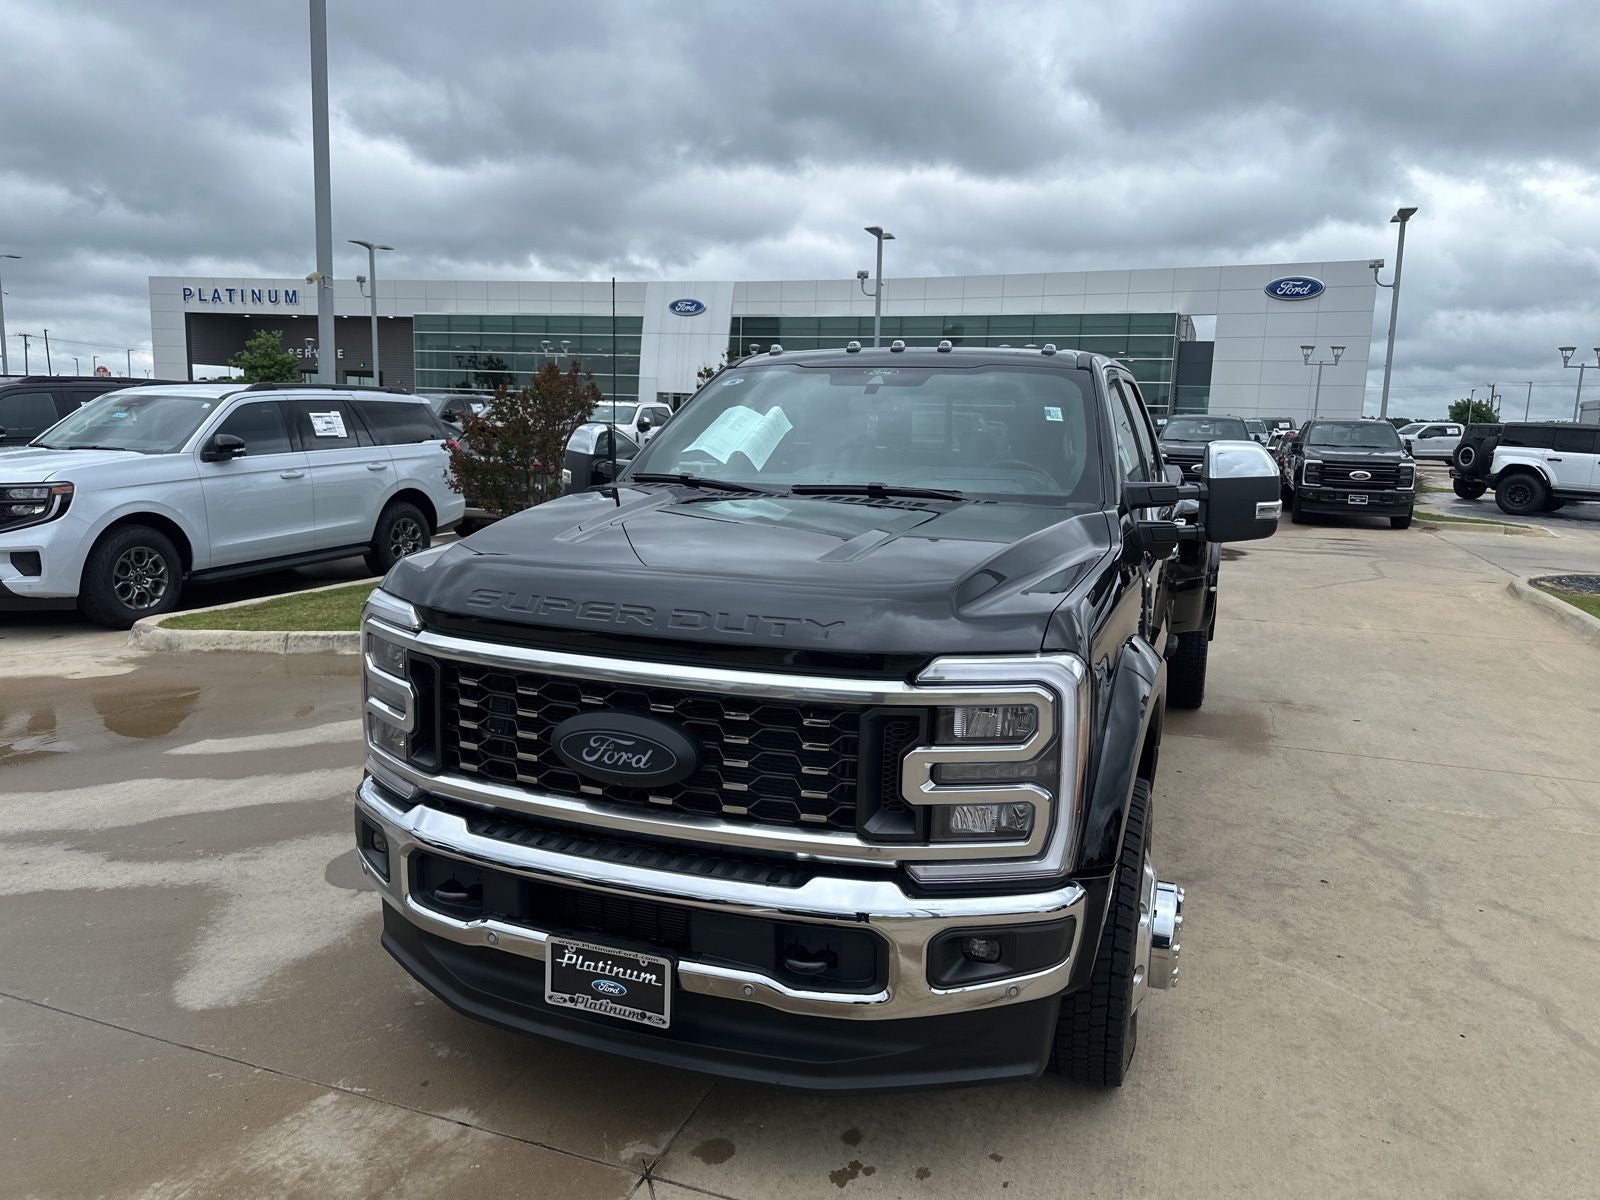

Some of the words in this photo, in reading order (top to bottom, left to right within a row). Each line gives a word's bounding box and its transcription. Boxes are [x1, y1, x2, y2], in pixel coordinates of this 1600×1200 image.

[183, 287, 298, 304] PLATINUM
[1276, 281, 1312, 295] Ford
[675, 301, 697, 311] Ford
[288, 348, 344, 359] SERVE
[465, 588, 658, 627] SUPER
[667, 608, 846, 641] DUTY
[582, 734, 652, 770] Ford
[555, 949, 663, 986] Platinum
[598, 983, 620, 995] Ford
[574, 994, 641, 1020] Platinum
